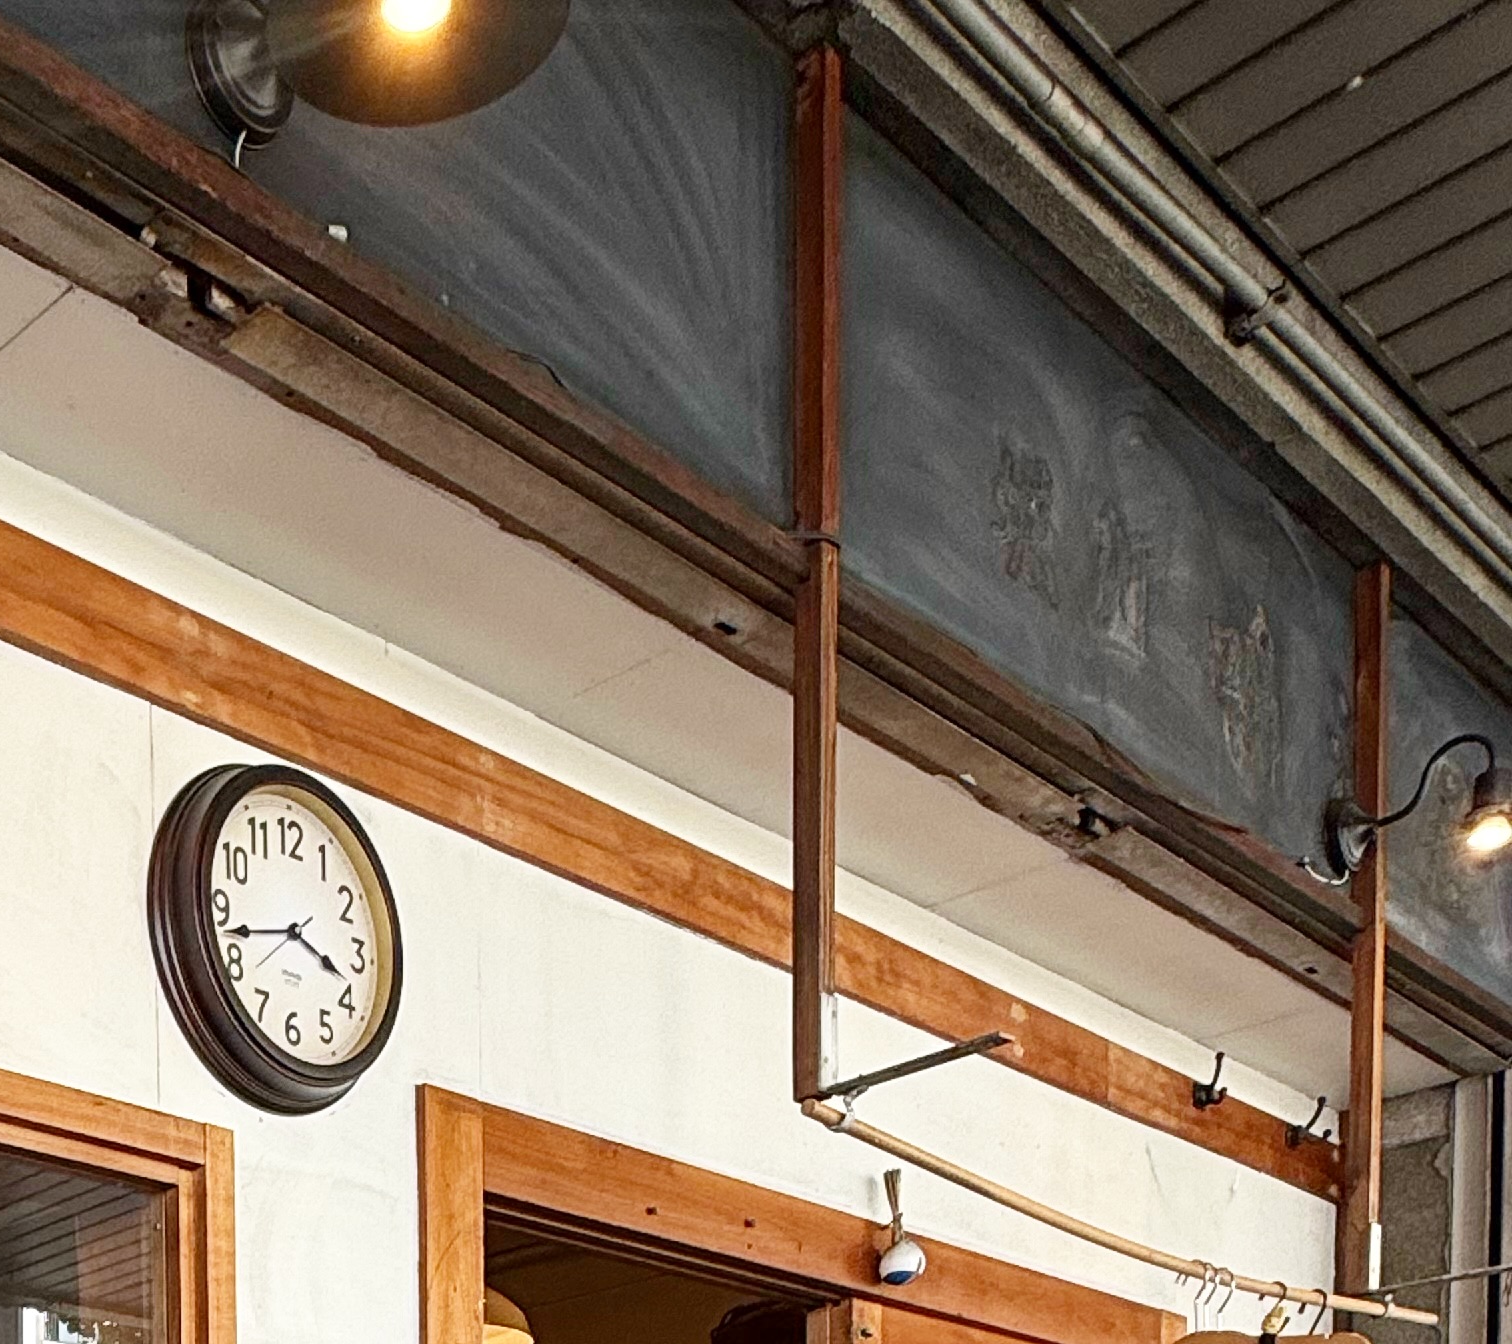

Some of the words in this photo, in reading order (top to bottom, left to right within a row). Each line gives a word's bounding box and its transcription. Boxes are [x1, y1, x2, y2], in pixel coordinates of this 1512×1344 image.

[247, 816, 268, 860] 11
[277, 817, 303, 861] 12
[223, 841, 248, 885] 10
[318, 844, 327, 882] 1
[213, 889, 230, 927] 9
[337, 885, 354, 924] 2
[227, 943, 244, 982] 8
[350, 937, 366, 974] 3
[254, 987, 270, 1023] 7
[337, 983, 356, 1019] 4
[284, 1011, 301, 1046] 6
[319, 1008, 334, 1045] 5
